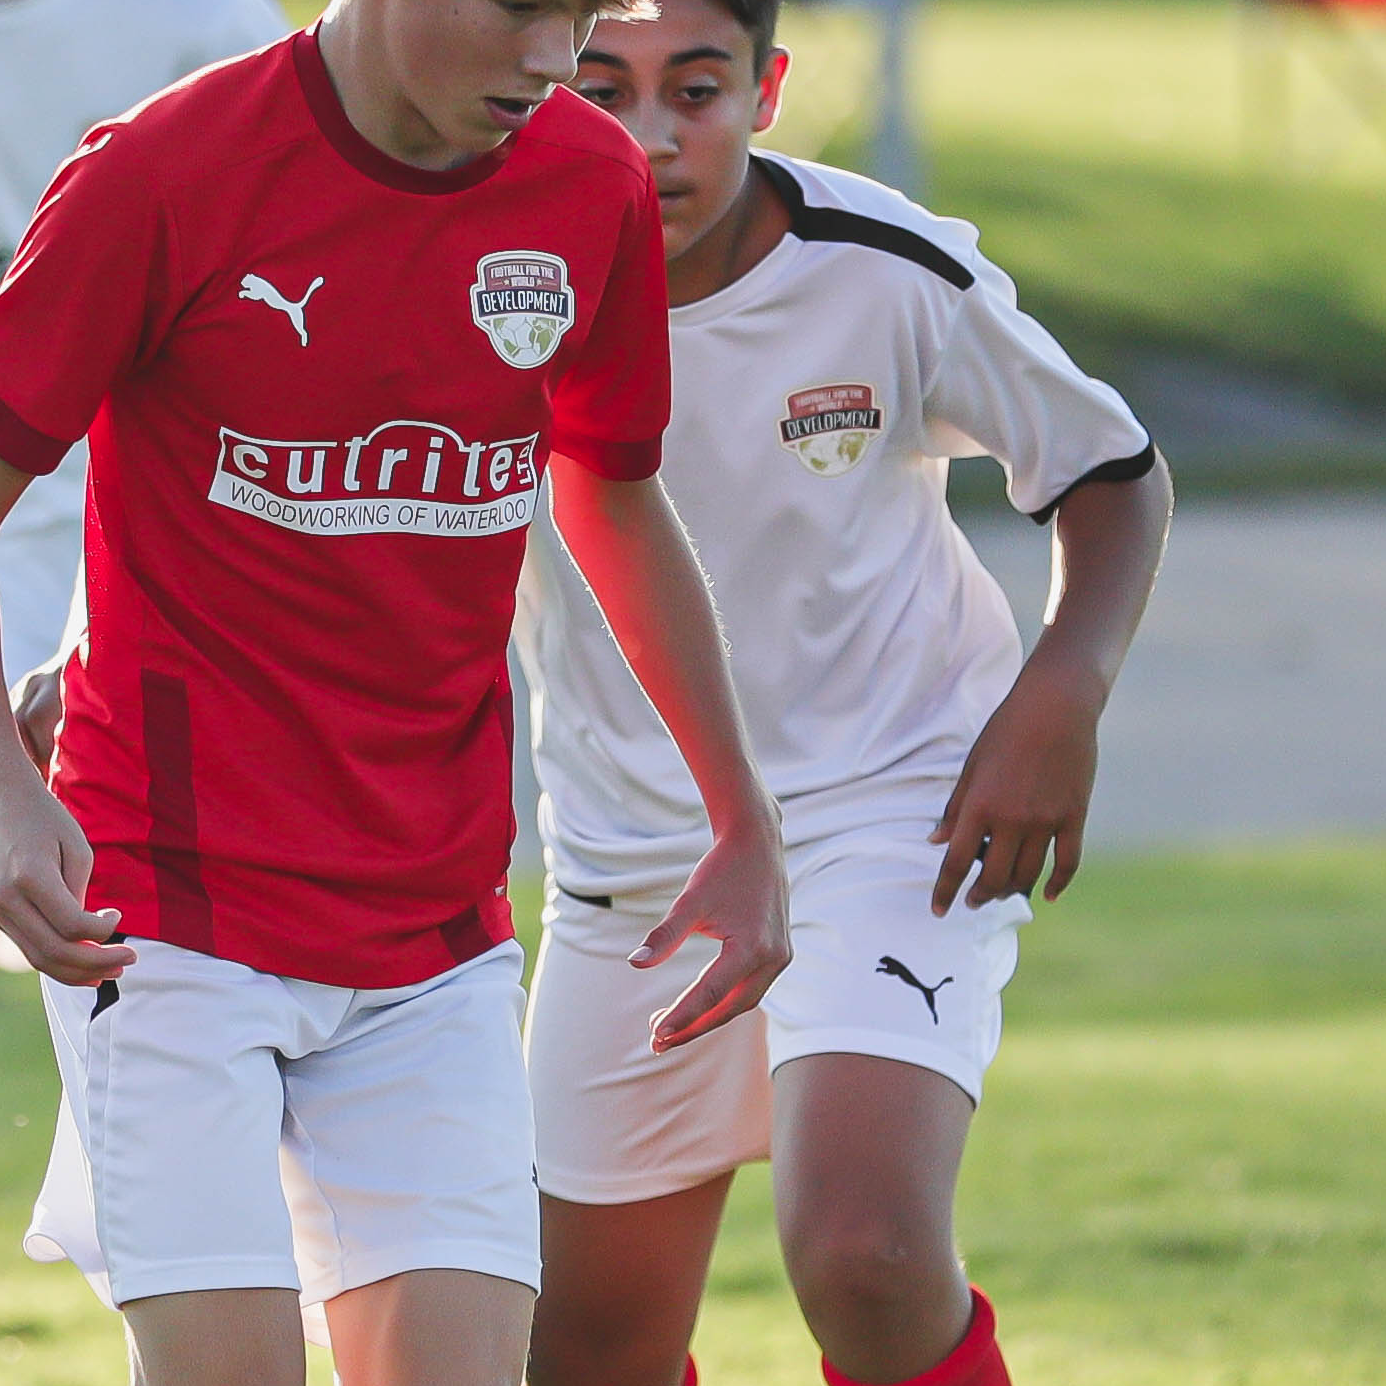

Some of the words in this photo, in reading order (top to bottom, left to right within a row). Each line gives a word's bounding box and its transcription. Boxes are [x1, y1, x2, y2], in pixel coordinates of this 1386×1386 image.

[490, 265, 525, 279] FOOTBALL
[482, 290, 566, 314] DEVELOPMENT
[785, 410, 876, 439] DEVELOPMENT
[232, 436, 513, 497] cutrite
[517, 444, 532, 485] LTD
[230, 480, 390, 528] WOODWORKING
[397, 505, 428, 526] OF
[435, 498, 527, 530] WATERLOO
